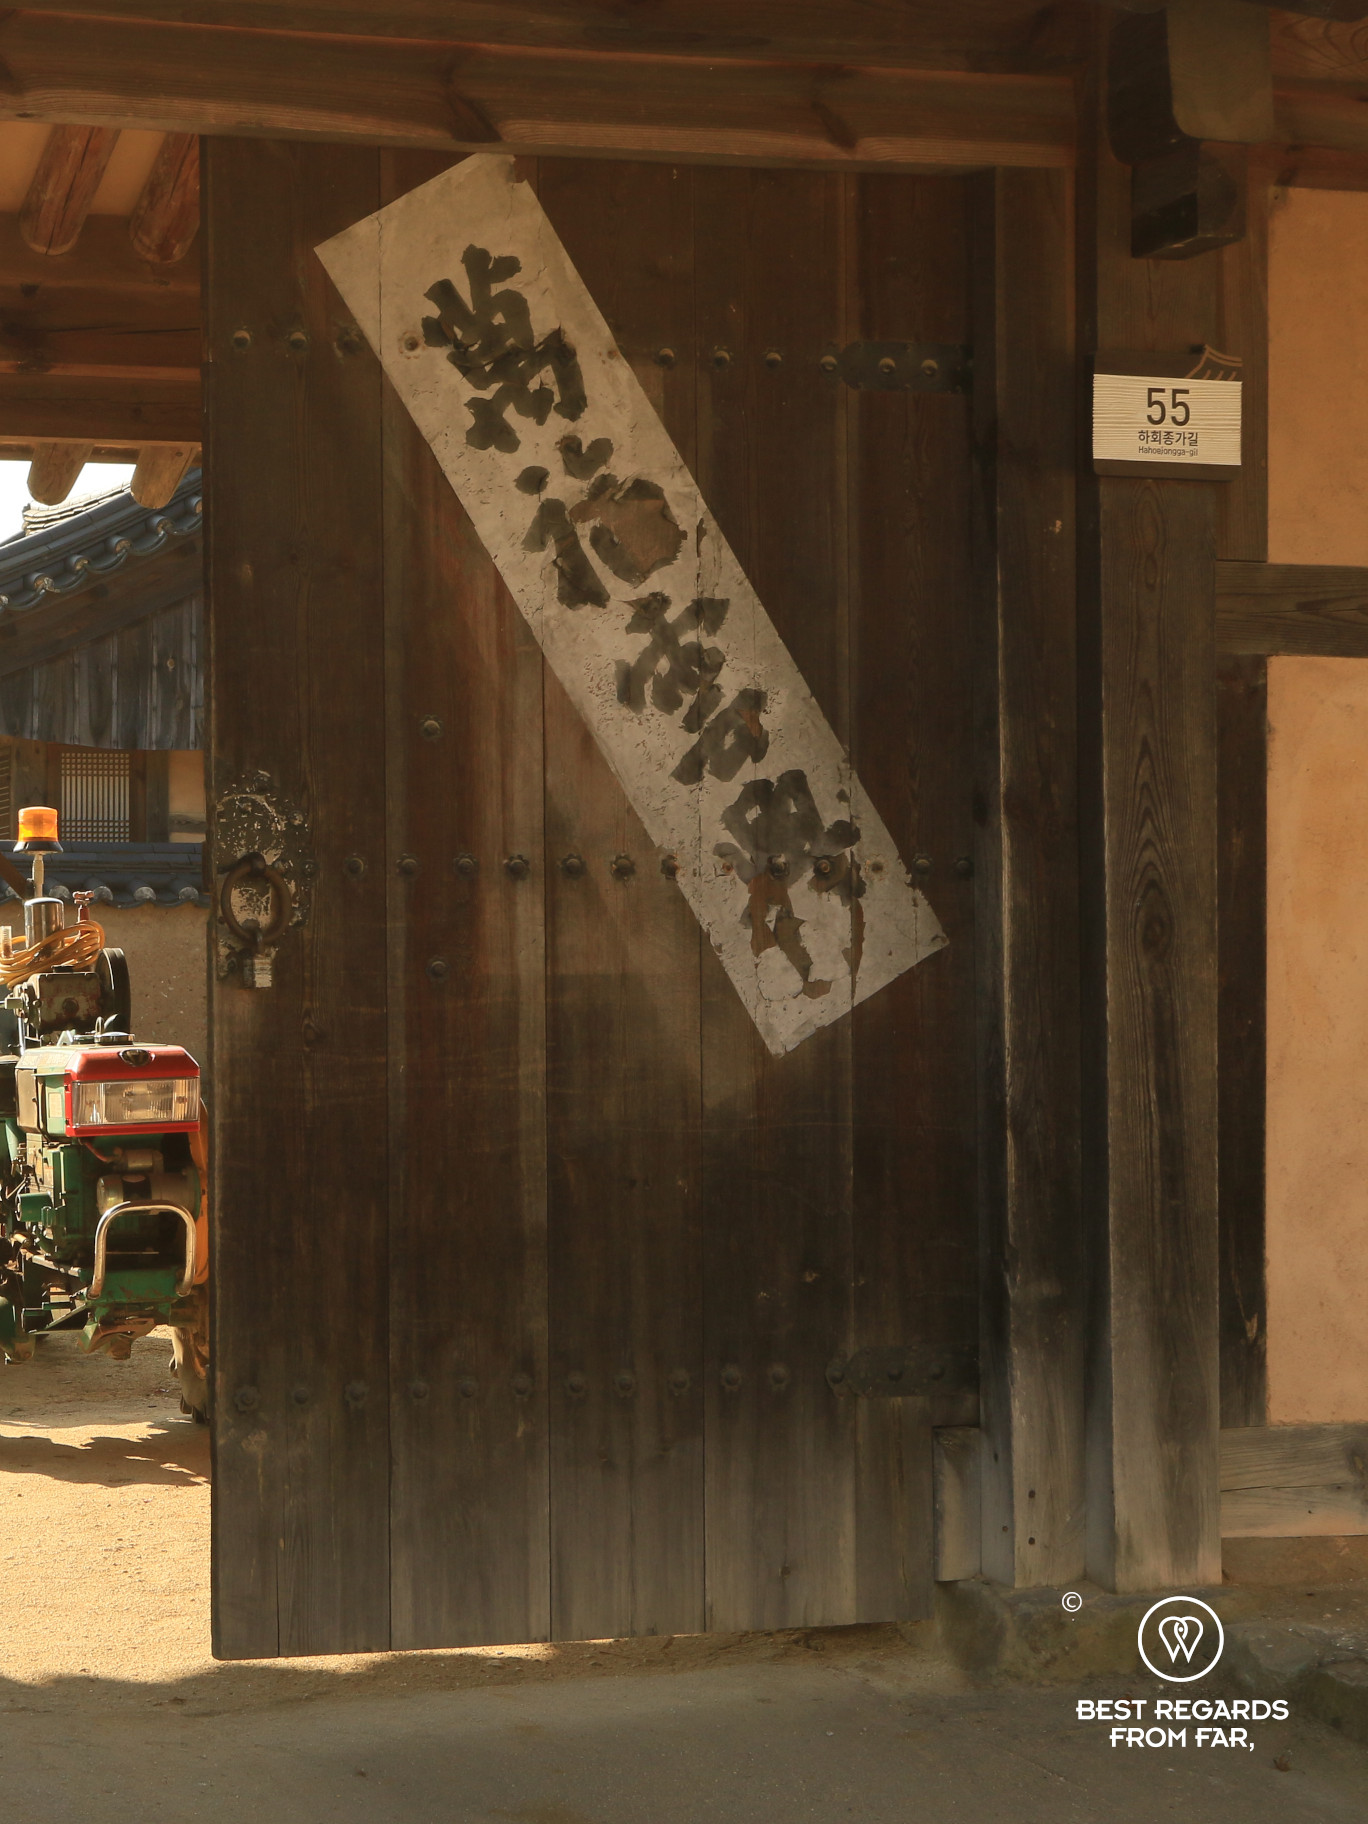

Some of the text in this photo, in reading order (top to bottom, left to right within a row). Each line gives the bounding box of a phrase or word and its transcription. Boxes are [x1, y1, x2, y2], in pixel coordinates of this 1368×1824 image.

[1146, 387, 1191, 426] 55
[1137, 429, 1199, 447] 하회종가길
[1138, 445, 1199, 457] Hahoejongga-gil
